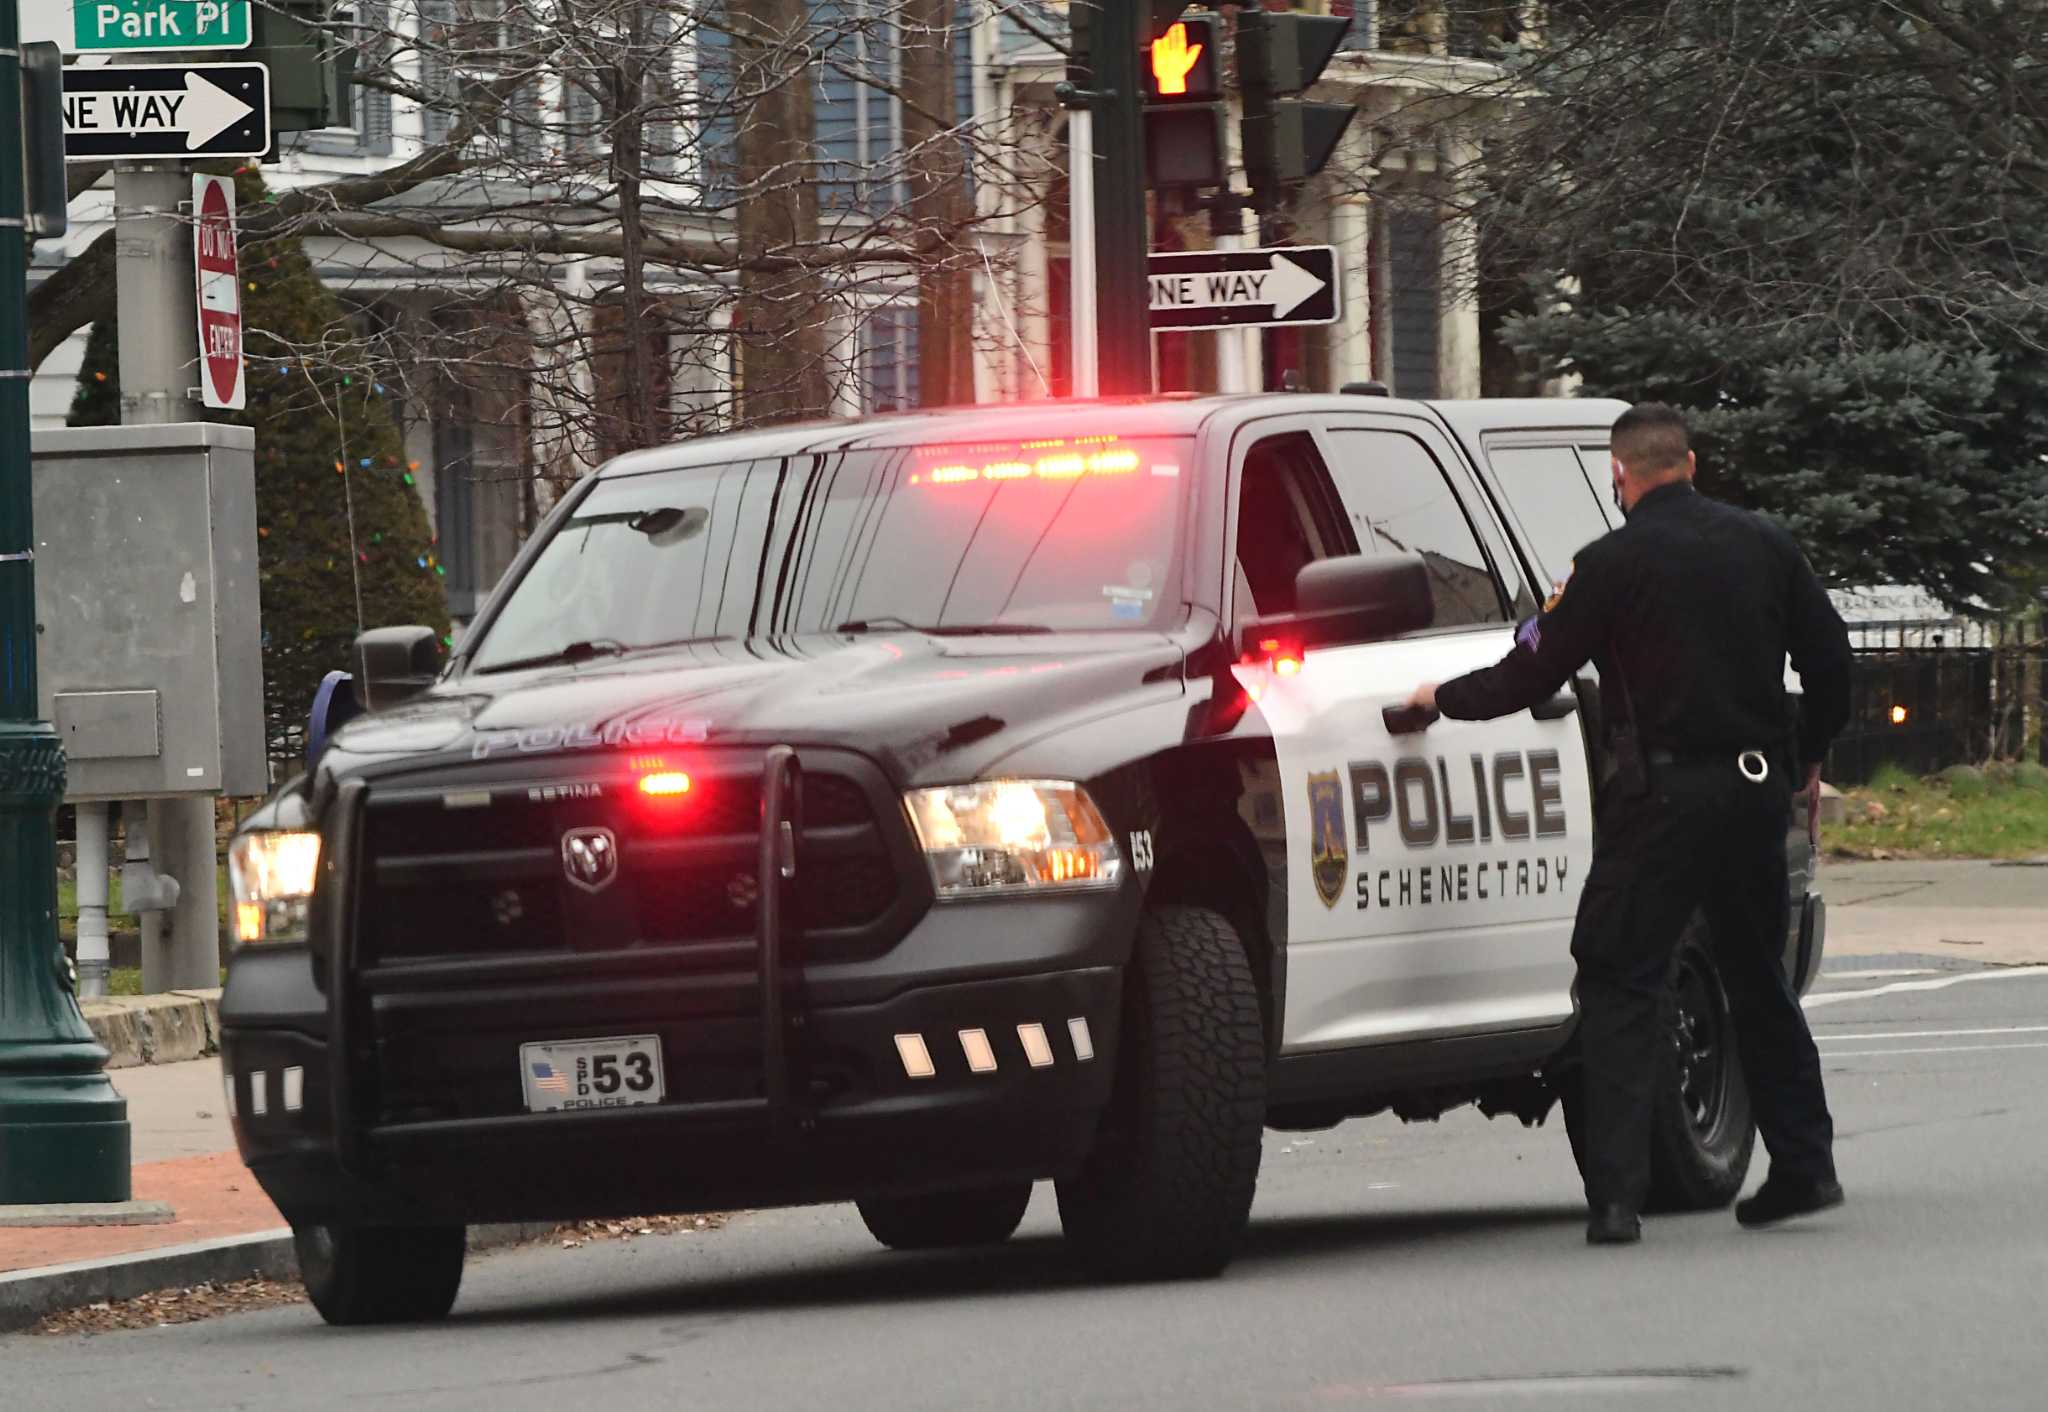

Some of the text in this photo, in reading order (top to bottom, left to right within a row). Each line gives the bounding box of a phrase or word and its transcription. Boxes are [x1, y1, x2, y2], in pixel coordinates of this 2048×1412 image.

[97, 4, 229, 38] Park Pl
[63, 94, 185, 128] NE WAY
[1150, 273, 1267, 305] NE WAY
[472, 719, 709, 760] POLICE
[1348, 749, 1566, 854] POLICE
[1356, 855, 1567, 910] SCHENECTADY
[576, 1056, 590, 1096] SPD
[593, 1051, 654, 1094] 53
[563, 1096, 627, 1110] POLICE
